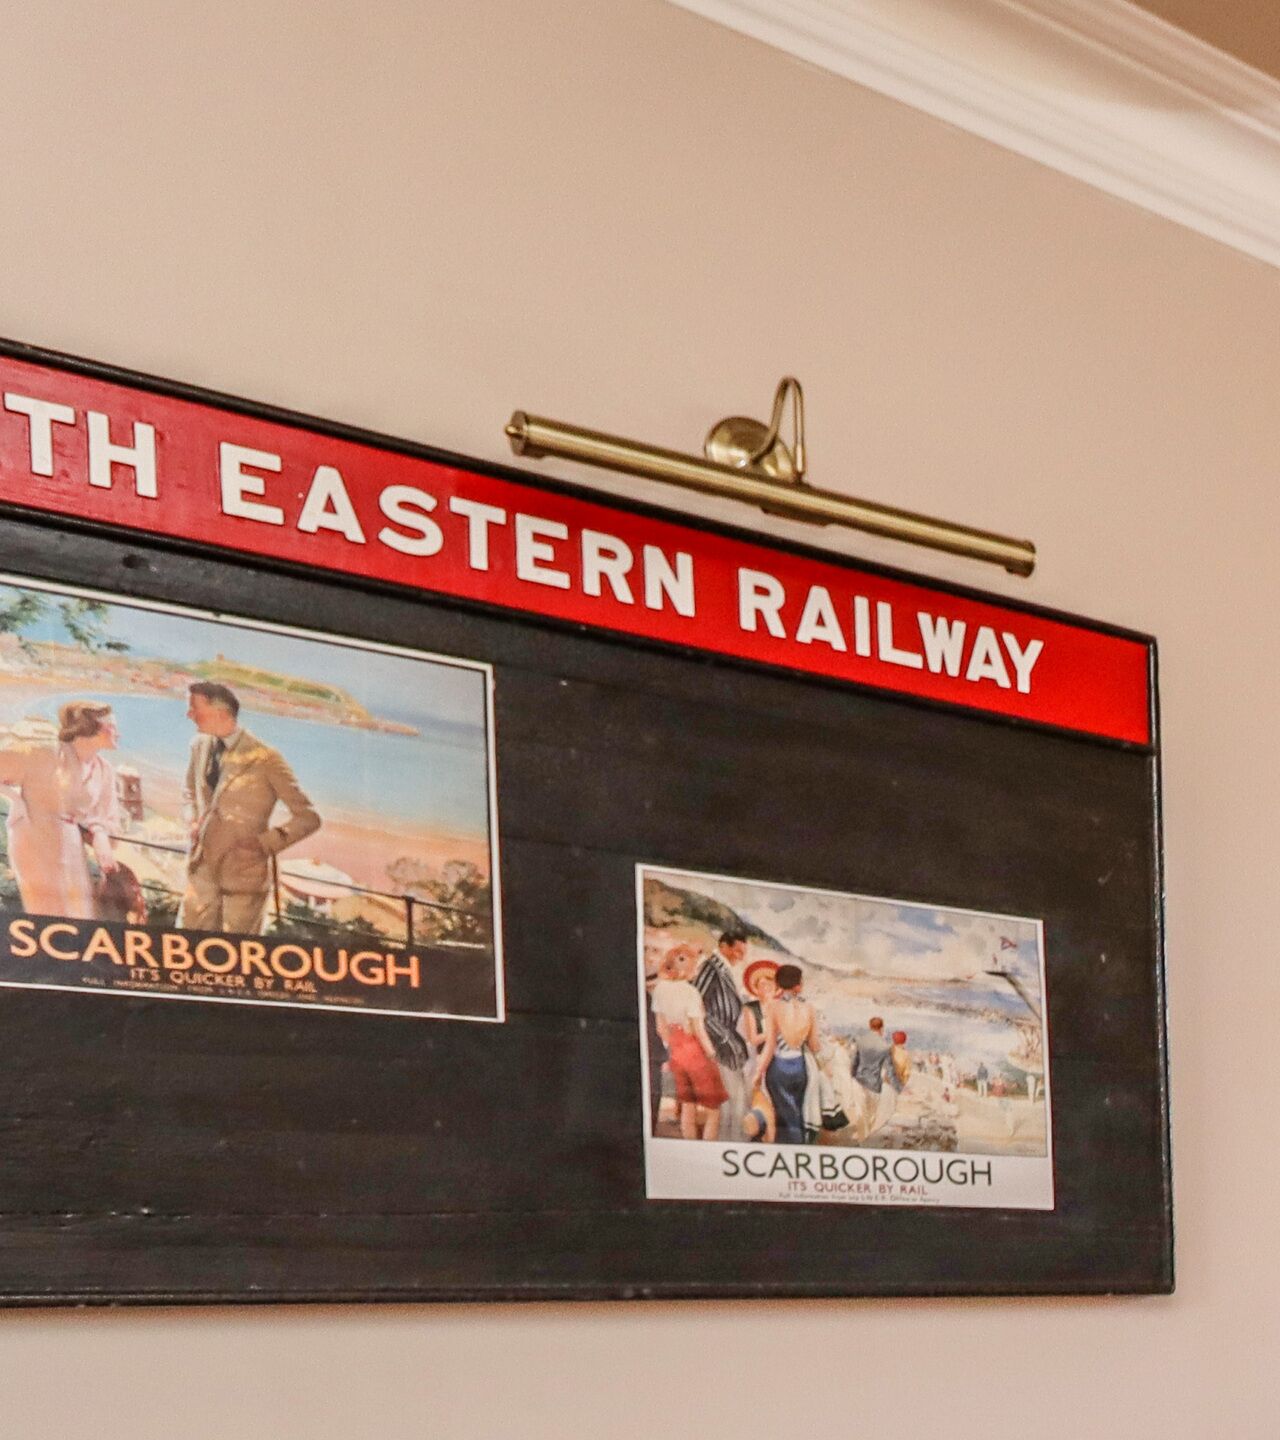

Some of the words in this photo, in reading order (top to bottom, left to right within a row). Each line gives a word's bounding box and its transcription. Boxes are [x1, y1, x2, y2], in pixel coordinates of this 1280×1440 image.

[4, 391, 158, 499] TH
[219, 441, 696, 618] EASTERN
[738, 567, 1045, 694] RAILWAY
[8, 918, 421, 989] SCARBOROUGH
[169, 970, 246, 988] QUICKER
[253, 975, 275, 990] BY
[284, 978, 318, 993] RAIL
[721, 1149, 993, 1187] SCARBOROUGH
[813, 1181, 872, 1194] QUICKER
[878, 1183, 894, 1195] BY
[900, 1184, 929, 1196] RAIL
